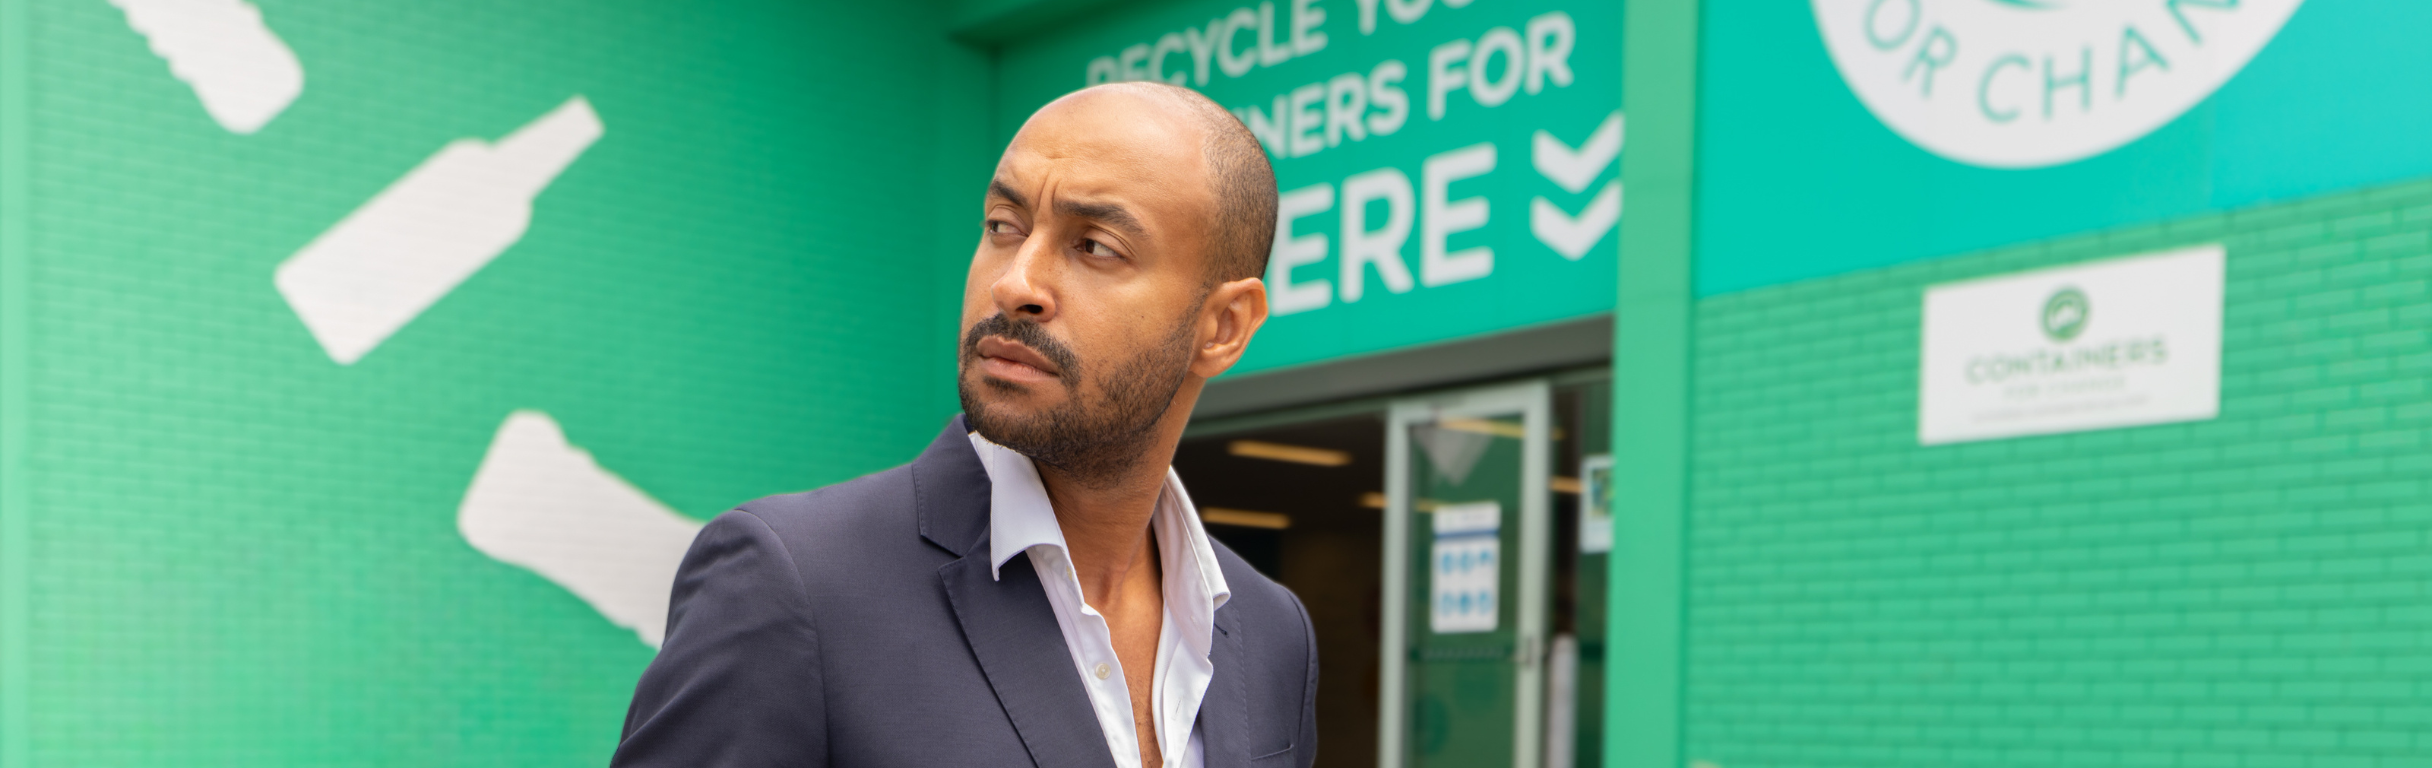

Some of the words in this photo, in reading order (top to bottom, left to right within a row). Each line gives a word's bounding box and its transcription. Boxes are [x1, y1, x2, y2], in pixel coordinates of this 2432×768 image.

[1426, 11, 1576, 122] FOR
[1975, 0, 2238, 122] CHAN
[1267, 141, 1499, 317] ERE
[1965, 336, 2169, 386] CONTAINERS
